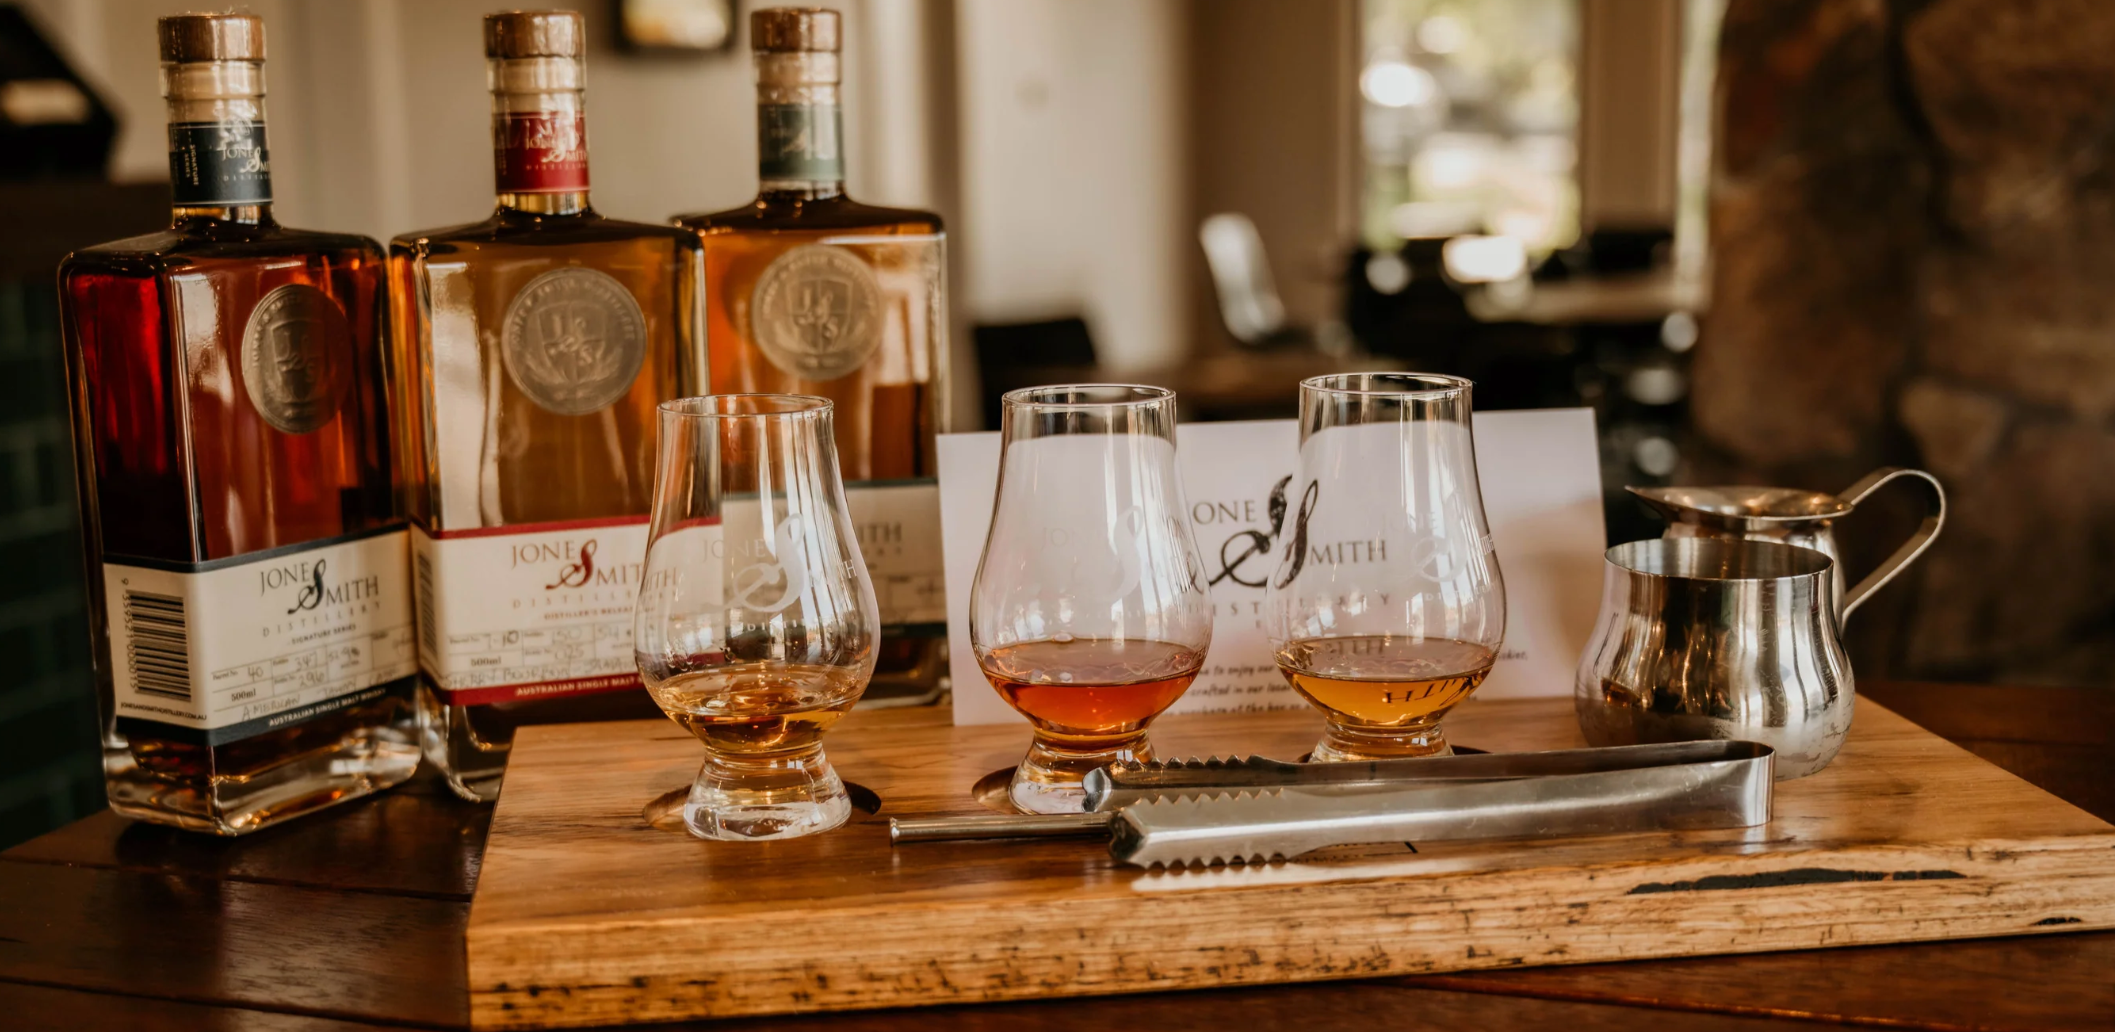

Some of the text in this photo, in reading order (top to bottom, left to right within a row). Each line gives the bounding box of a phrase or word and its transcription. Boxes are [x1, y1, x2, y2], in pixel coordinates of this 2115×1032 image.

[262, 602, 381, 638] DISTILLERY
[291, 624, 357, 646] SIGNATURE SERIES
[470, 656, 502, 667] 500ml
[231, 688, 257, 702] 500ml
[515, 675, 636, 697] AUSTRALIAN SINGLE MALT
[268, 707, 315, 727] AUSTRALIAN
[315, 701, 340, 715] SINGLE
[341, 694, 361, 708] MALT
